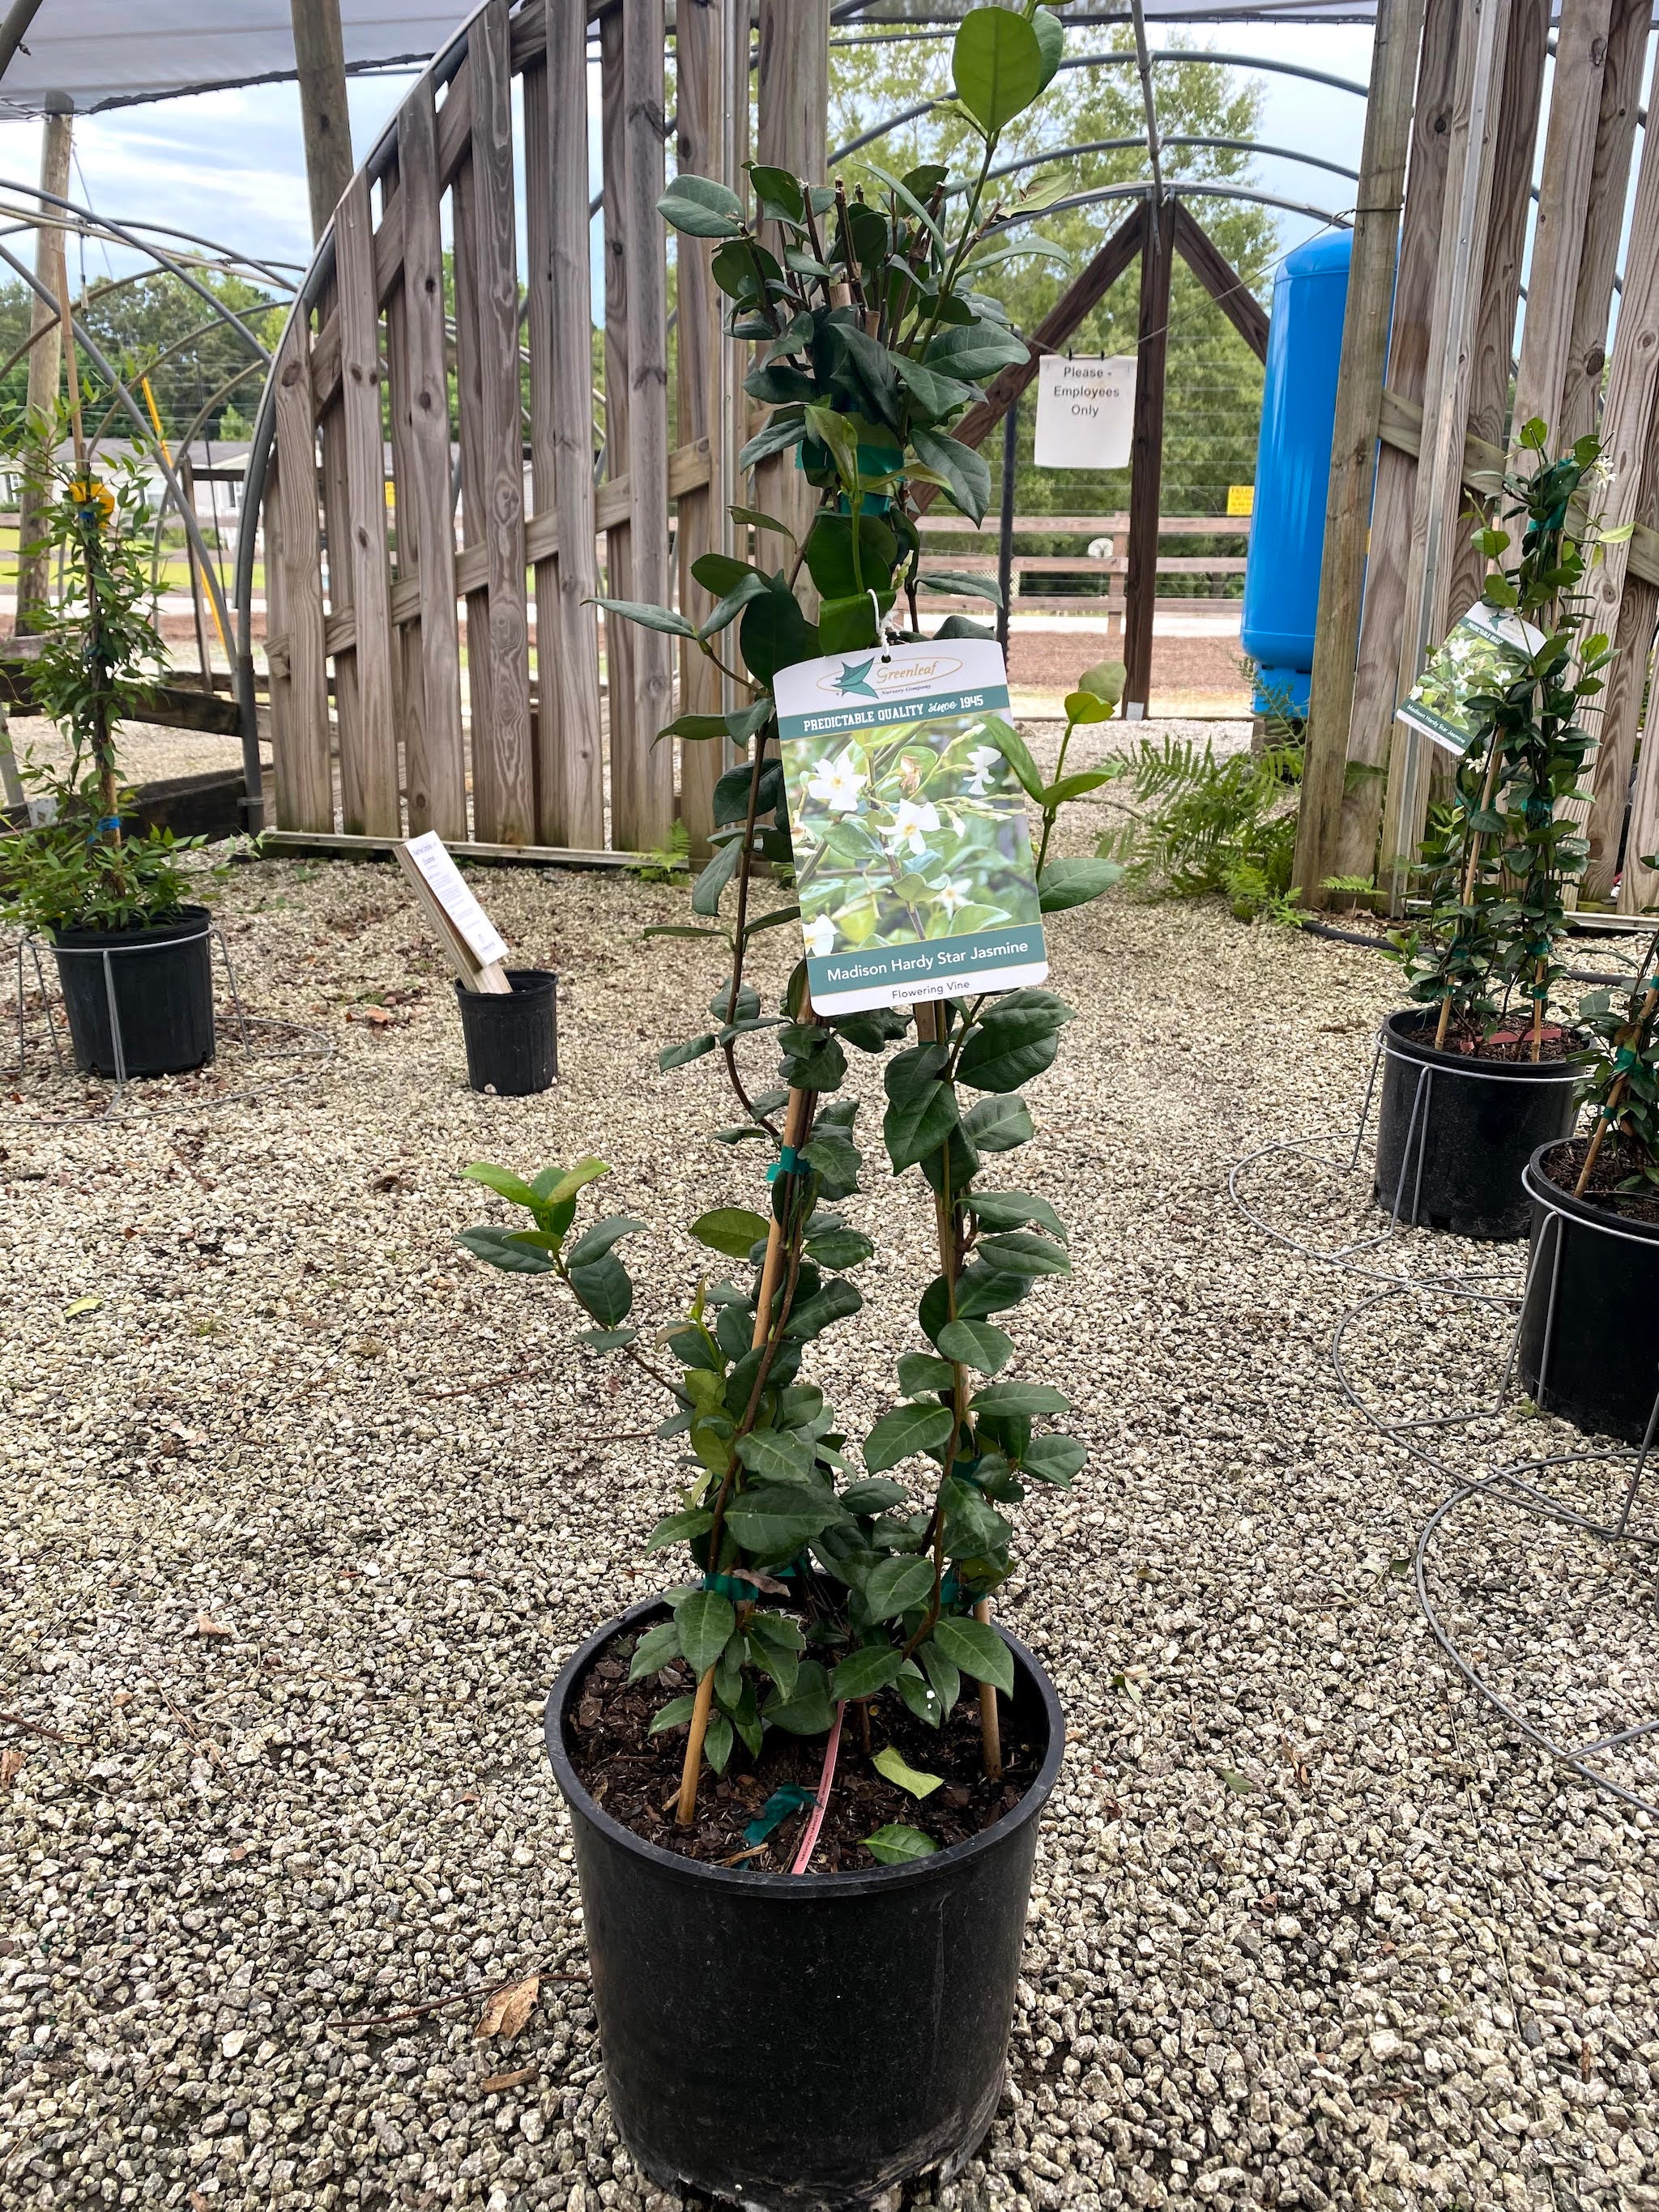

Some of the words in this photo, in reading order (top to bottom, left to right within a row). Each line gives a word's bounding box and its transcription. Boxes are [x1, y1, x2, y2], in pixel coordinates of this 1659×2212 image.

[1064, 366, 1103, 377] Please
[1054, 386, 1120, 399] Employees
[1071, 404, 1099, 417] Only
[876, 660, 939, 684] Greenleaf
[906, 684, 932, 693] Company
[803, 710, 875, 732] PREDICTABLE
[877, 704, 923, 720] QUALITY
[928, 700, 957, 714] since
[960, 694, 984, 710] 1945
[1407, 704, 1426, 719] Madison
[1425, 715, 1439, 728] Hardy
[1439, 723, 1448, 732] Star
[1448, 730, 1465, 744] Jasmine
[827, 961, 887, 982] Madison
[891, 954, 934, 972] Hardy
[937, 950, 966, 965] Star
[970, 941, 1029, 960] Jasmine
[892, 984, 944, 999] Flowering
[946, 981, 970, 991] Vine
